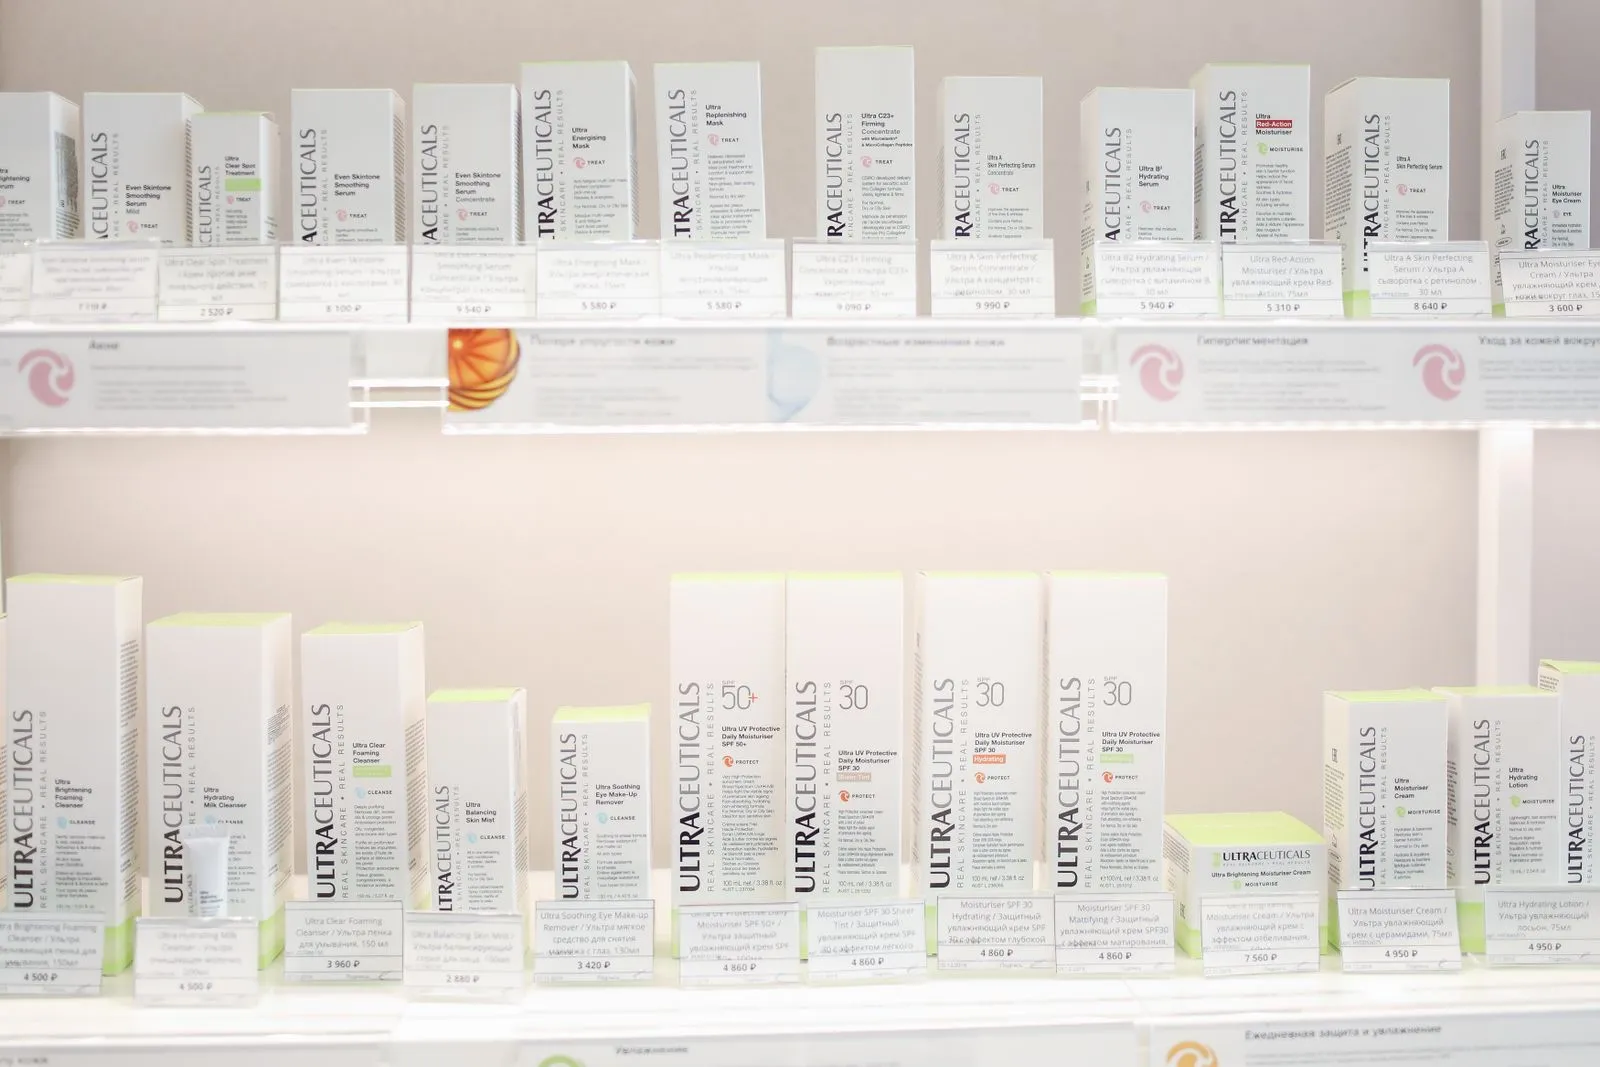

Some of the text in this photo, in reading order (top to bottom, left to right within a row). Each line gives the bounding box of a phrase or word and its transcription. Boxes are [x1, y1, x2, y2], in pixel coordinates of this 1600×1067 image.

[534, 89, 557, 239] TRACEUTICALS
[668, 89, 693, 238] TRACEUTICALS
[1219, 91, 1239, 245] LTRACEUTICALS
[721, 685, 758, 710] 50+
[839, 685, 869, 710] 30
[976, 682, 1005, 707] 30
[1103, 681, 1132, 706] 30
[13, 710, 37, 908] ULTRACEUTICALS
[162, 706, 183, 903] ULTRACEUTICALS
[311, 703, 338, 898] ULTRACEUTICALS
[435, 785, 454, 911] LTRACEUTICALS
[560, 733, 581, 899] ULTRACEUTICALS
[679, 682, 704, 892] ULTRACEUTICALS
[795, 680, 819, 893] ULTRACEUTICALS
[930, 678, 955, 888] ULTRACEUTICALS
[1057, 677, 1083, 888] ULTRACEUTICALS
[1223, 850, 1311, 862] ULTRACEUTICALS
[1474, 719, 1493, 884] ULTRACEUTICALS
[1568, 735, 1586, 884] ULTRACEUTICALS
[562, 912, 596, 922] Soothing
[598, 911, 612, 921] Eye
[614, 911, 649, 921] Make-up
[960, 901, 1033, 909] Moisturiser SPF 30
